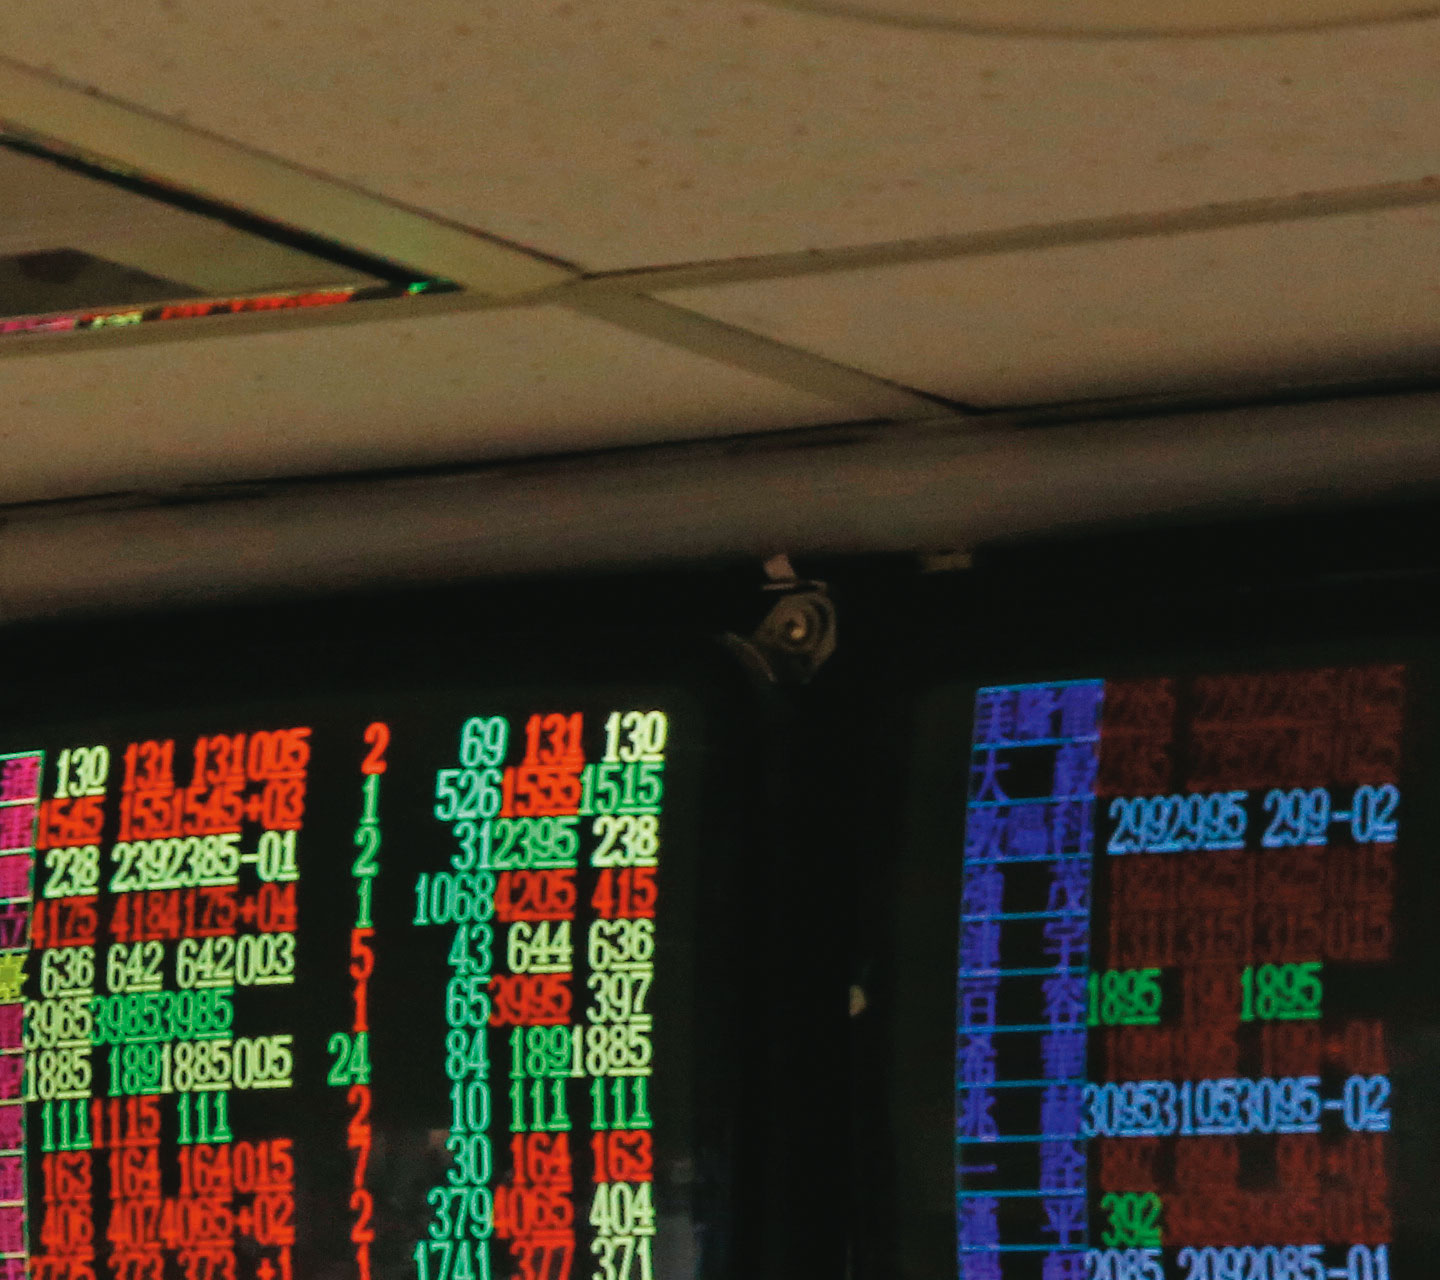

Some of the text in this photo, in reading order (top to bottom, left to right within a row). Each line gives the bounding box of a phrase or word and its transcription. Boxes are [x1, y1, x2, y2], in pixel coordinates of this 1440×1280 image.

[56, 711, 666, 798] 130 69 130
[436, 769, 501, 818] 526
[45, 815, 658, 896] 238 238
[414, 873, 495, 924] 1068
[41, 920, 654, 999] 636 642 43 644 636
[446, 972, 651, 1027] 65 397
[1241, 964, 1322, 1024] 1895
[329, 1029, 489, 1085] 24 84
[450, 1078, 651, 1133] 10 111
[448, 1136, 492, 1186] 30
[591, 1183, 654, 1235] 404
